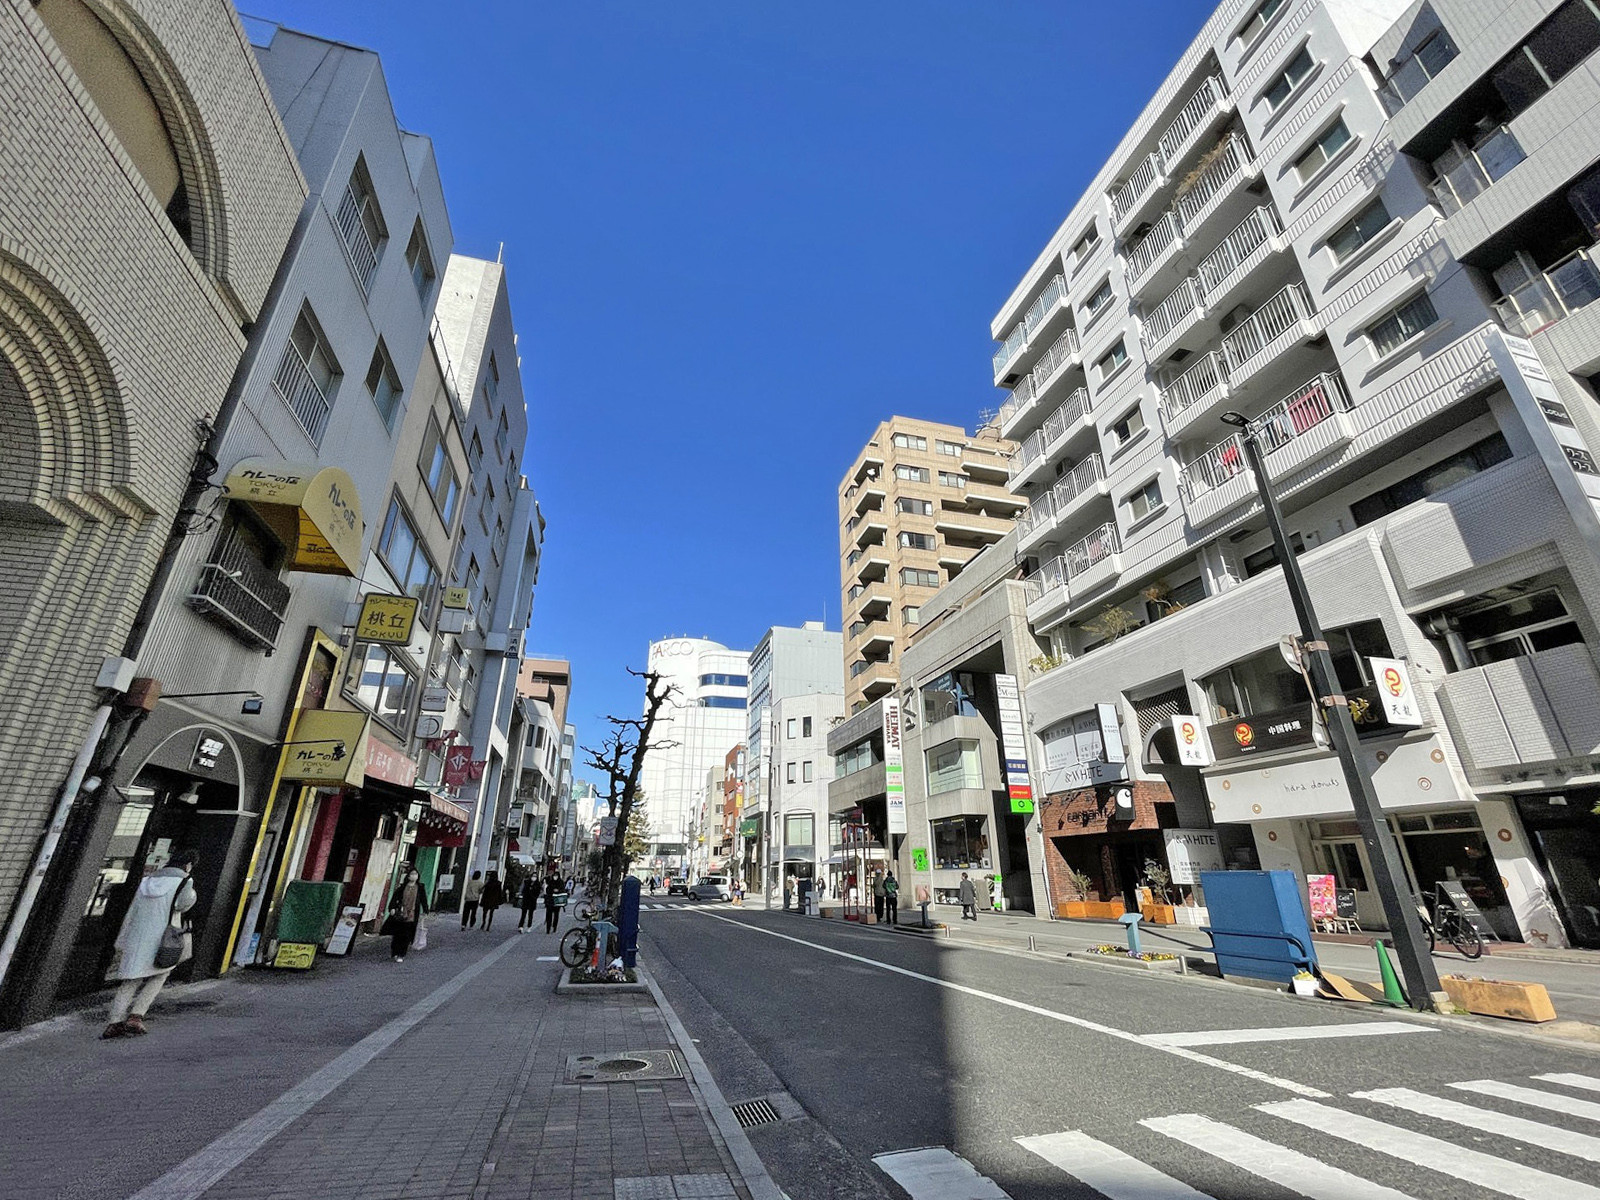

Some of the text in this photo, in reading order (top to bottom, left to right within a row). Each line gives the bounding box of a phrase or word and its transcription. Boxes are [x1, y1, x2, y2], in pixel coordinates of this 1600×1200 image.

[242, 470, 301, 485] カレーの店
[367, 610, 406, 629] 桃丘
[363, 627, 403, 639] TOKYU
[889, 705, 900, 750] HEIMAT
[1267, 720, 1302, 735] 中国料理
[1283, 783, 1306, 792] hara
